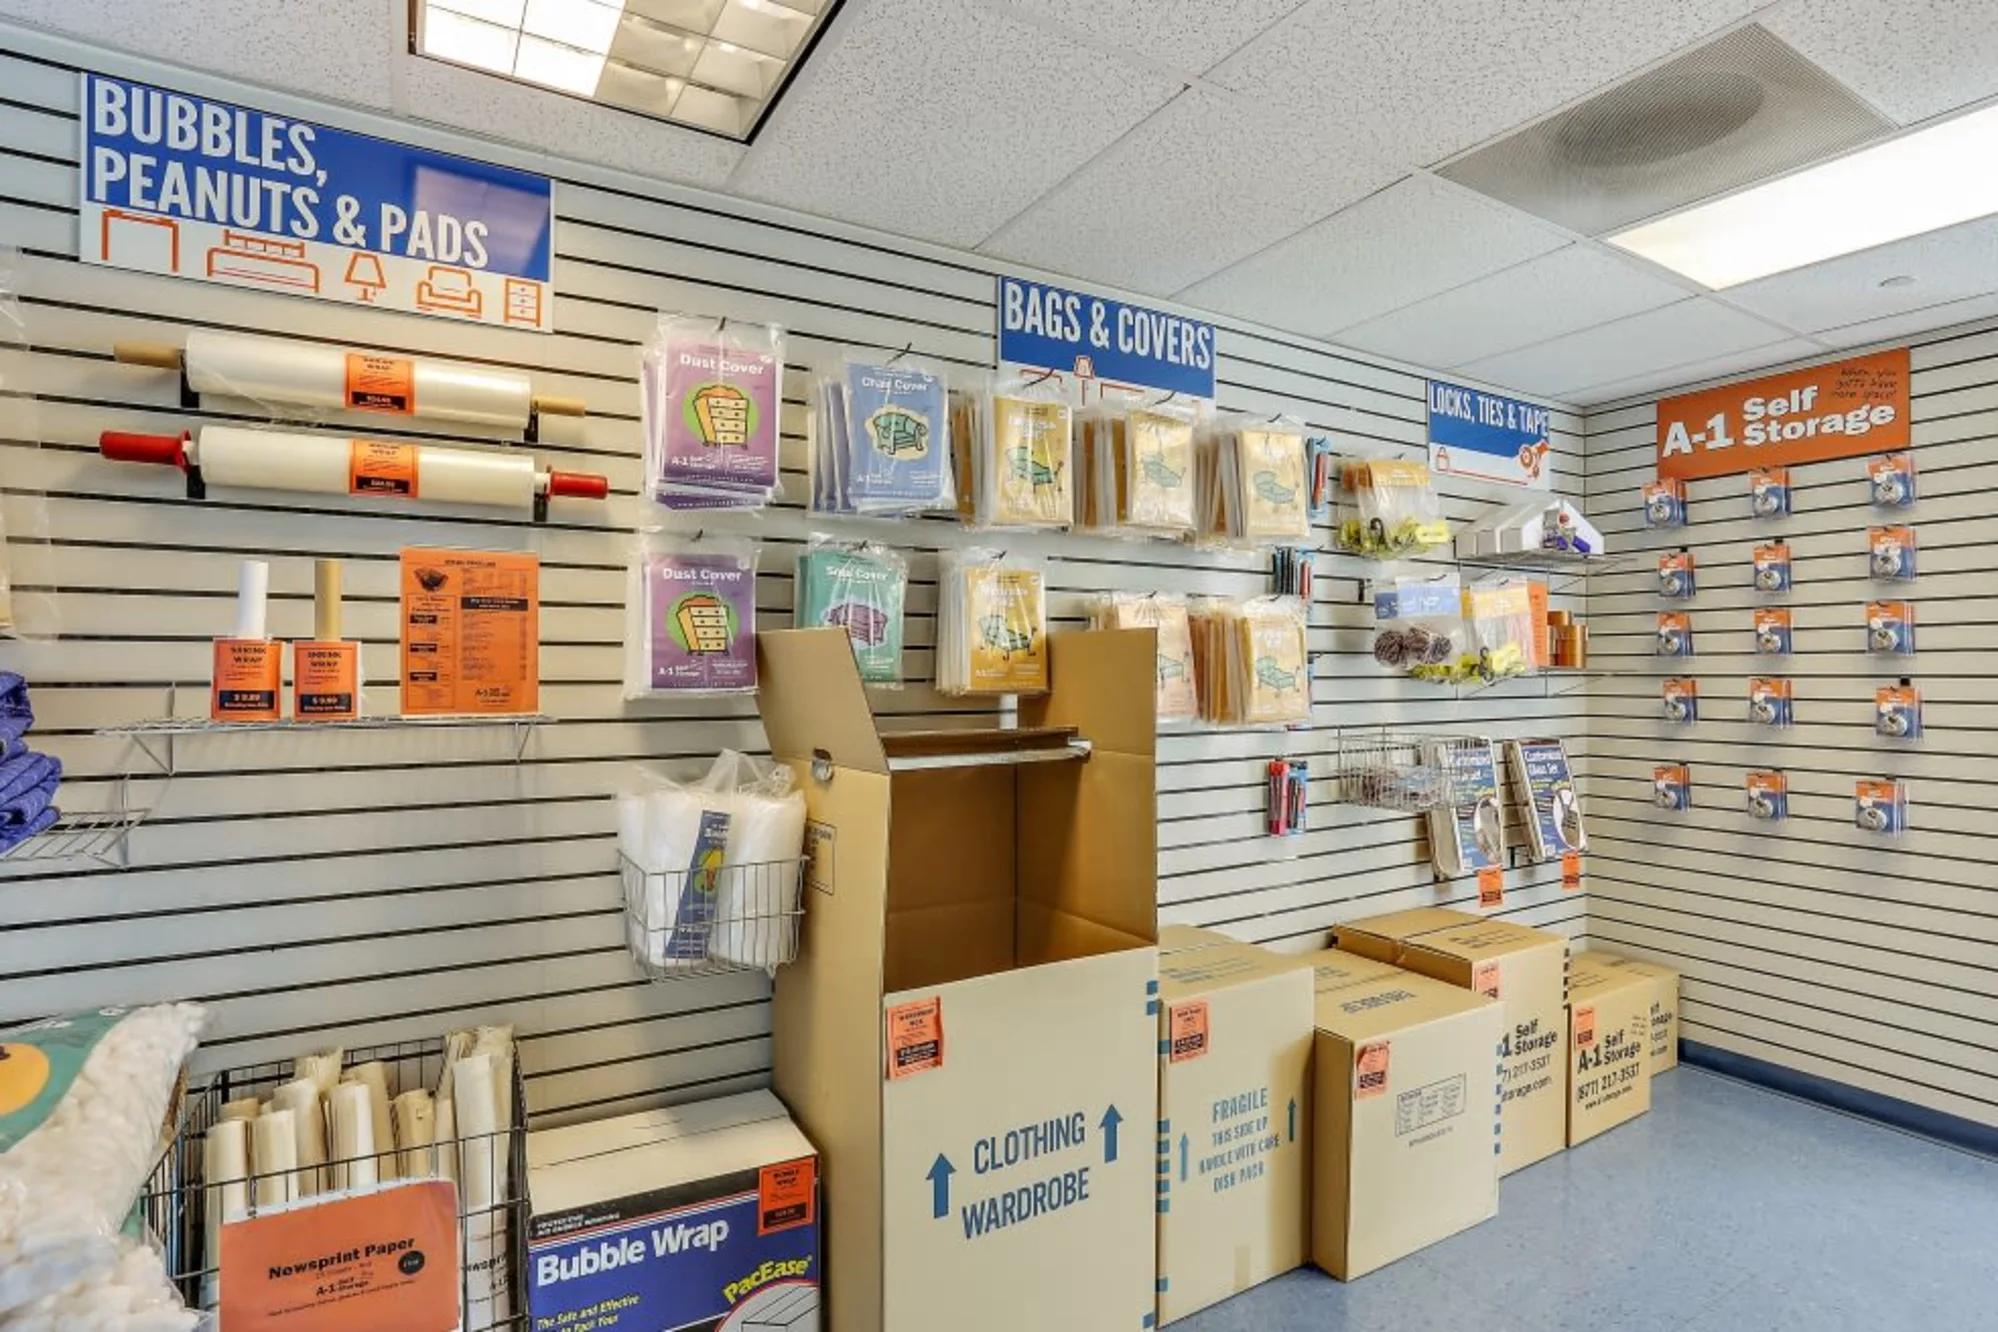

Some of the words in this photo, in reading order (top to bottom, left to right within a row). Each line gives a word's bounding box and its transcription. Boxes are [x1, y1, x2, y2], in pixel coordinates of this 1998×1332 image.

[94, 78, 328, 188] BUBBLES,
[94, 145, 320, 239] PEANUTS
[332, 194, 367, 248] &
[380, 202, 489, 268] PADS
[1004, 281, 1082, 343] BAGS
[1089, 301, 1110, 349] &
[1117, 307, 1212, 370] COVERS
[679, 352, 716, 370] Dust
[720, 359, 765, 375] Cover
[894, 379, 929, 392] Cover
[1743, 384, 1819, 422] Self
[1430, 384, 1476, 424] LOCKS,
[1477, 394, 1504, 427] TIES
[1507, 404, 1518, 429] &
[1518, 405, 1549, 437] TAPE
[1743, 402, 1896, 447] Storage
[1662, 411, 1736, 459] A-1
[662, 567, 697, 580] Dust
[700, 568, 742, 581] Cover
[855, 568, 888, 581] Cover
[1514, 1030, 1558, 1056] Storage
[1515, 1018, 1539, 1039] Self
[1605, 1029, 1625, 1050] Self
[1577, 1043, 1604, 1074] A-1
[1603, 1040, 1642, 1066] Storage
[1212, 1087, 1268, 1124] FRAGILE
[973, 1111, 1086, 1175] CLOTHING
[1212, 1128, 1232, 1147] THIS
[1213, 1171, 1236, 1193] DISH
[961, 1166, 1091, 1240] WARDROBE
[268, 1250, 361, 1280] Newsprint
[364, 1237, 416, 1258] Paper
[536, 1236, 647, 1287] Bubble
[651, 1219, 730, 1258] Wrap
[315, 1283, 336, 1296] A-1
[722, 1258, 810, 1304] PacEase
[537, 1316, 555, 1332] The
[556, 1309, 579, 1326] Safe
[580, 1303, 599, 1319] and
[600, 1292, 641, 1314] Effective
